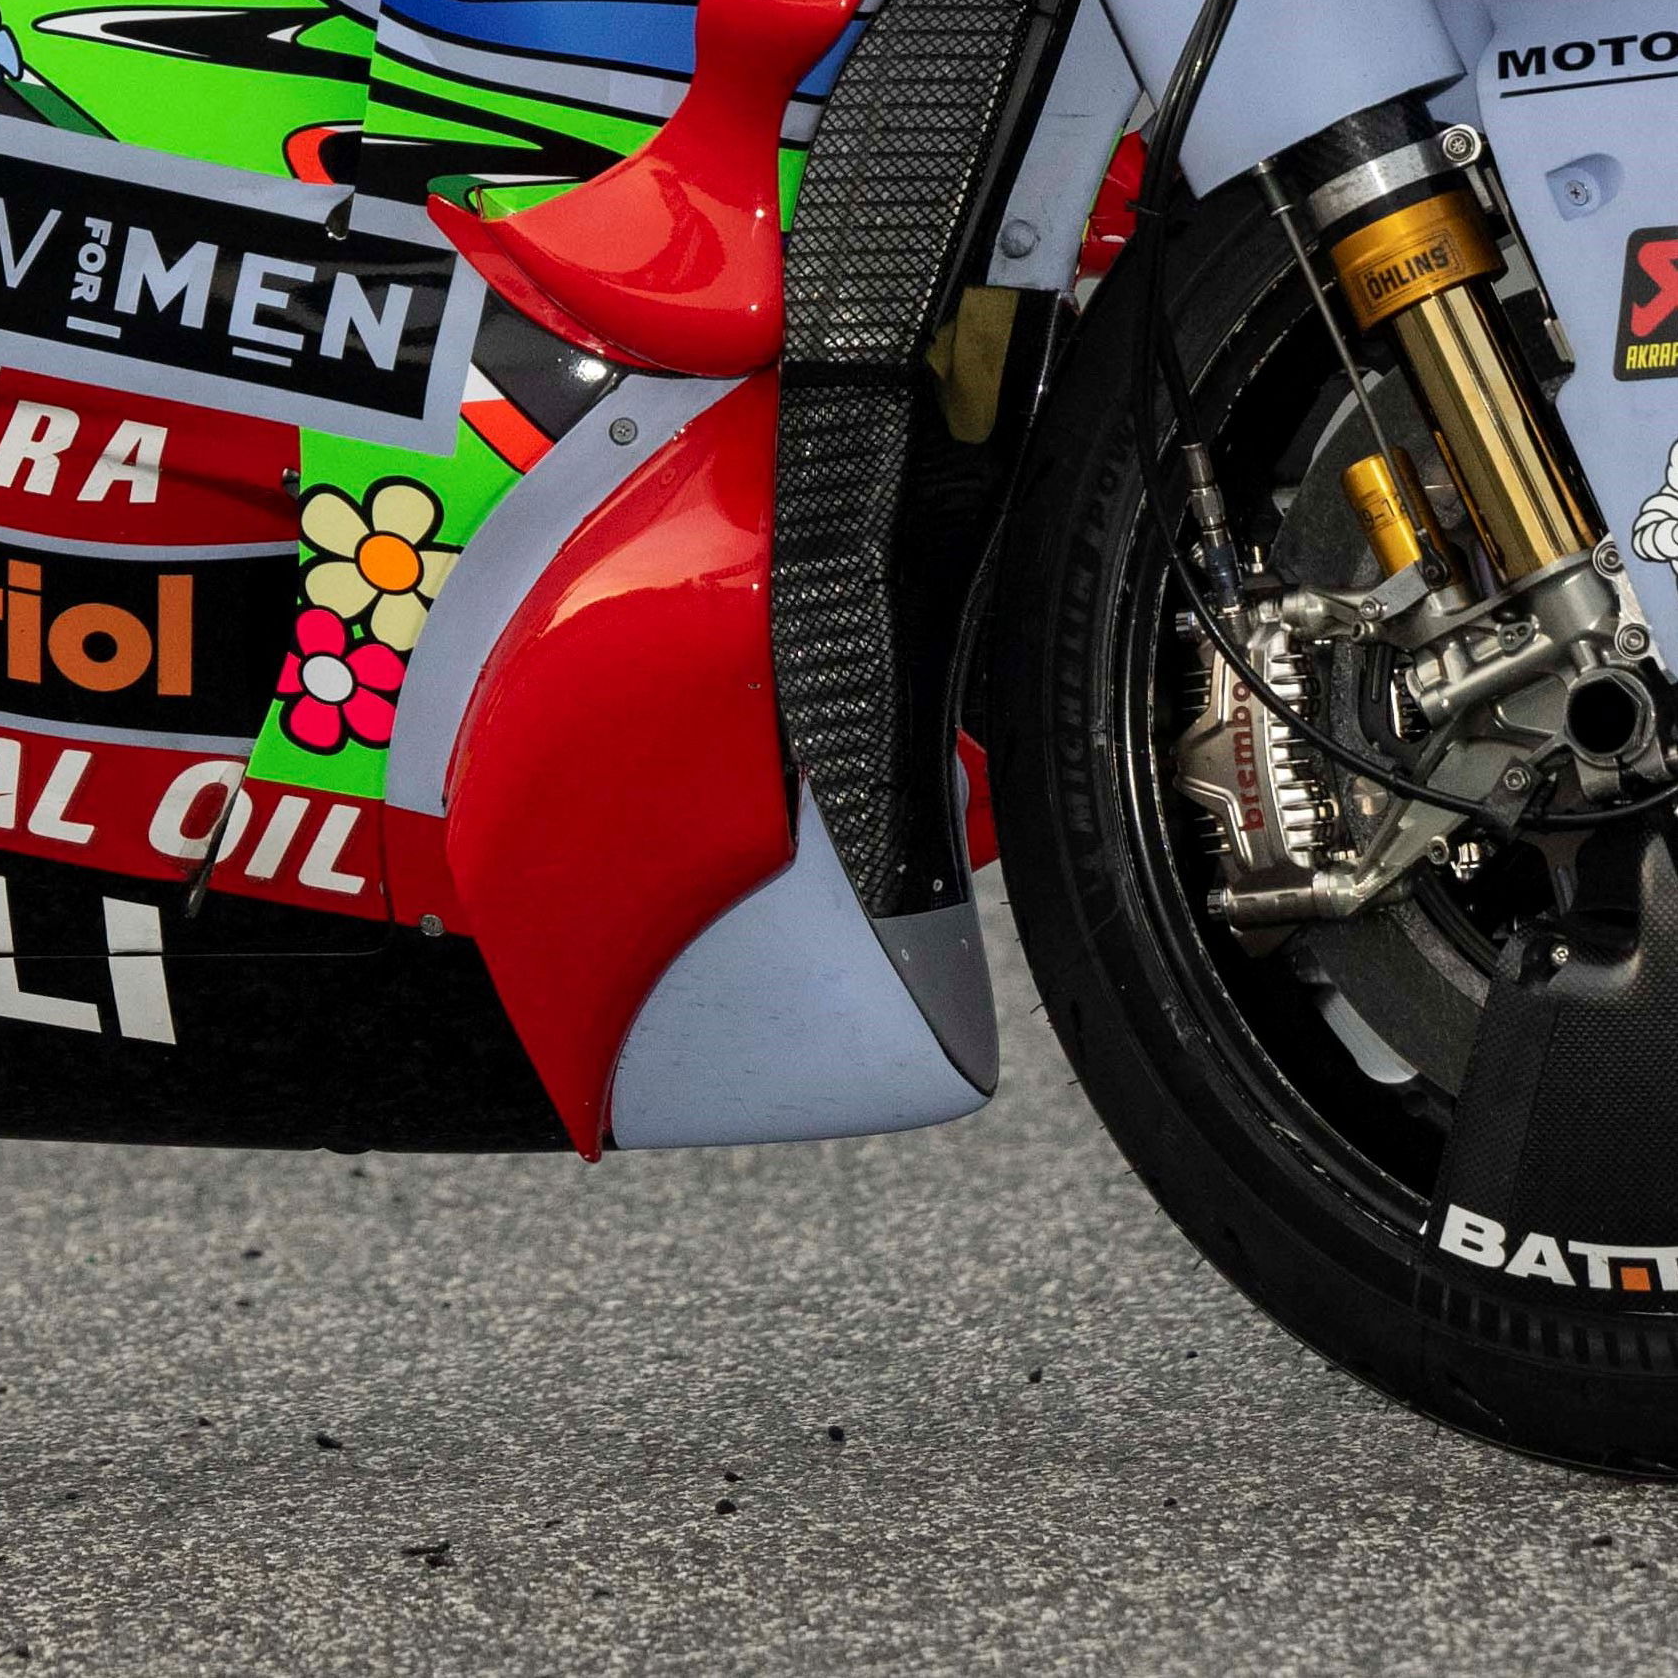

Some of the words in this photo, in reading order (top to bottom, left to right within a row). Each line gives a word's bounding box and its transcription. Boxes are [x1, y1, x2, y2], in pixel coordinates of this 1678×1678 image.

[70, 215, 112, 303] FOR
[114, 225, 413, 372] MEN
[1365, 244, 1450, 300] ÖHLINS
[1225, 681, 1265, 831] brembo
[148, 759, 366, 898] OIL
